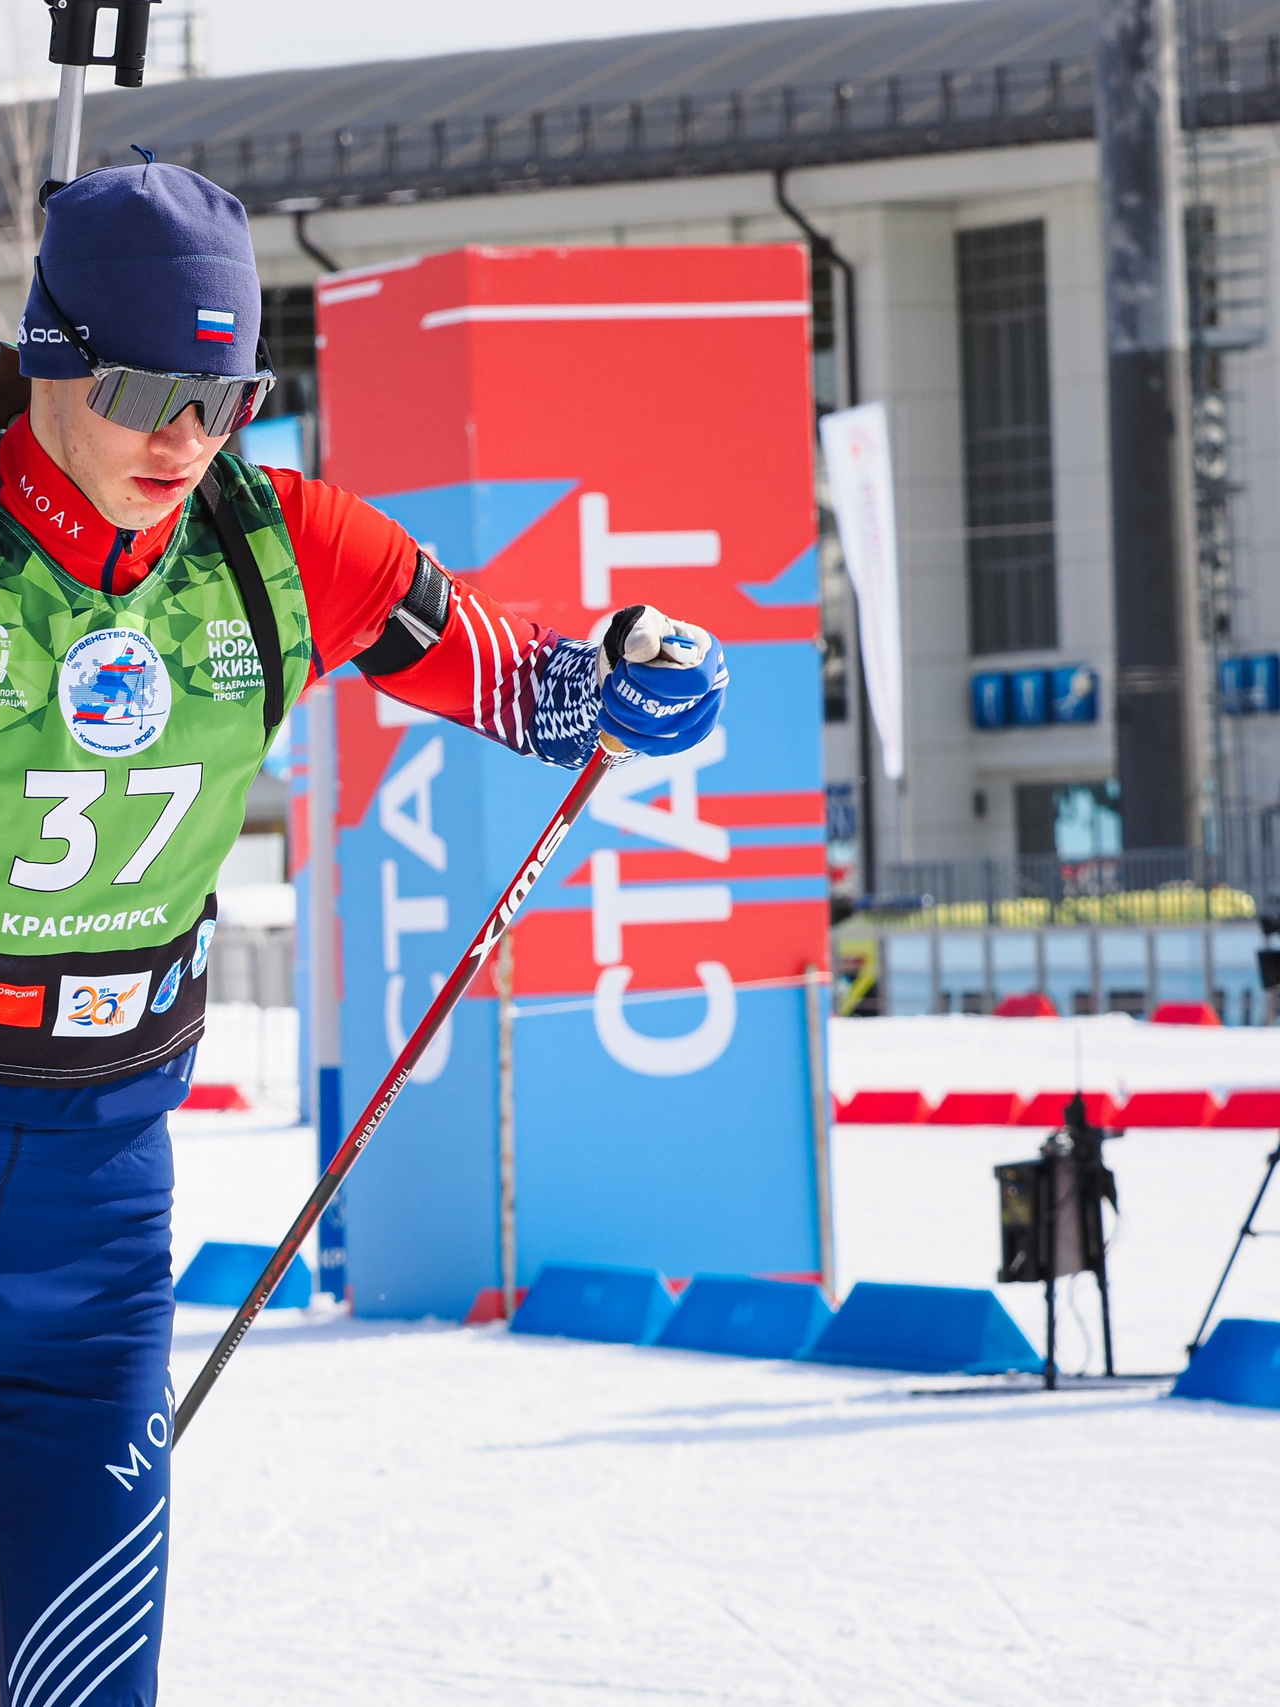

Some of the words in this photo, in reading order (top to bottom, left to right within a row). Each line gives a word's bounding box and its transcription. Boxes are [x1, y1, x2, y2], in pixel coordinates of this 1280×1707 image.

[19, 475, 84, 539] MOAX
[66, 631, 126, 666] ПЕРВЕНСТВО
[127, 631, 158, 663] РОССИИ
[210, 659, 263, 678] ЖИЗН
[213, 691, 245, 701] ПРОЕКТ
[79, 732, 131, 752] Красноярск
[134, 725, 156, 746] 2023
[579, 492, 737, 1077] СТАТ
[8, 762, 204, 892] 37
[1, 903, 170, 937] КРАСНОЯРСК
[384, 1067, 411, 1101] TRIAC
[354, 1116, 378, 1149] AERO
